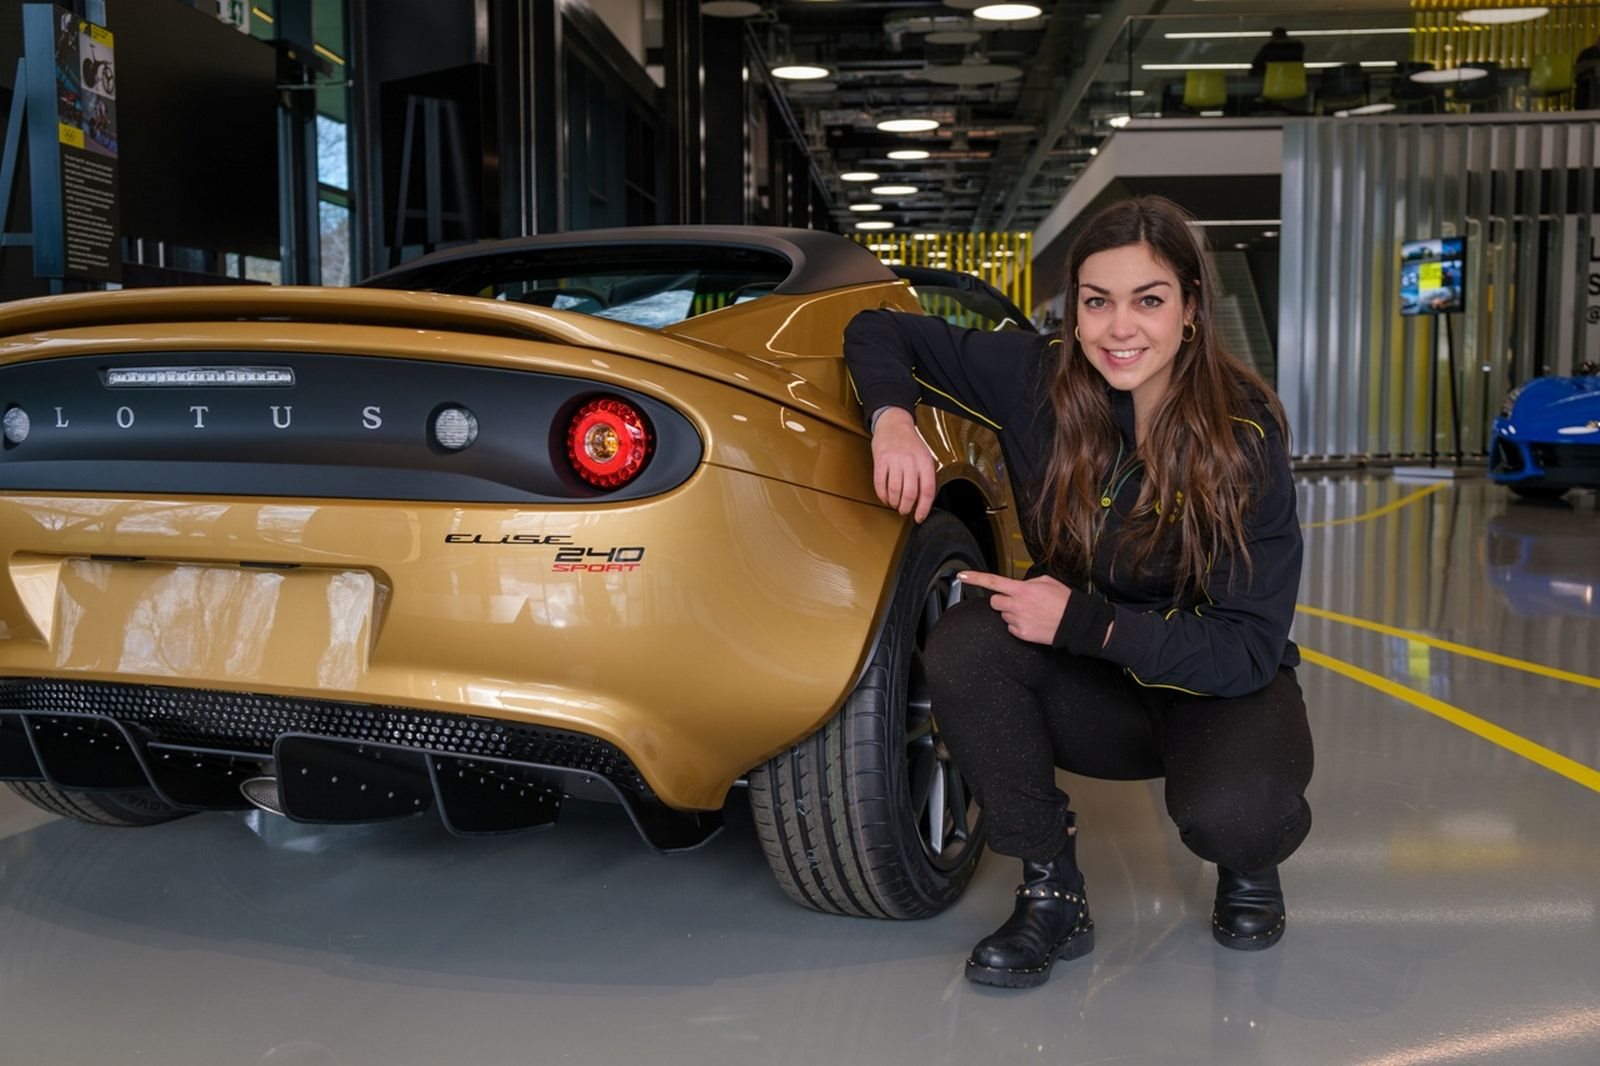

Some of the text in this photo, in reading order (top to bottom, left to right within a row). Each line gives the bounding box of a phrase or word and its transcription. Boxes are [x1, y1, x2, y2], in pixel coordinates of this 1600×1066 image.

[54, 406, 383, 429] LOTUS
[554, 547, 645, 563] 240
[551, 563, 640, 573] SPORT
